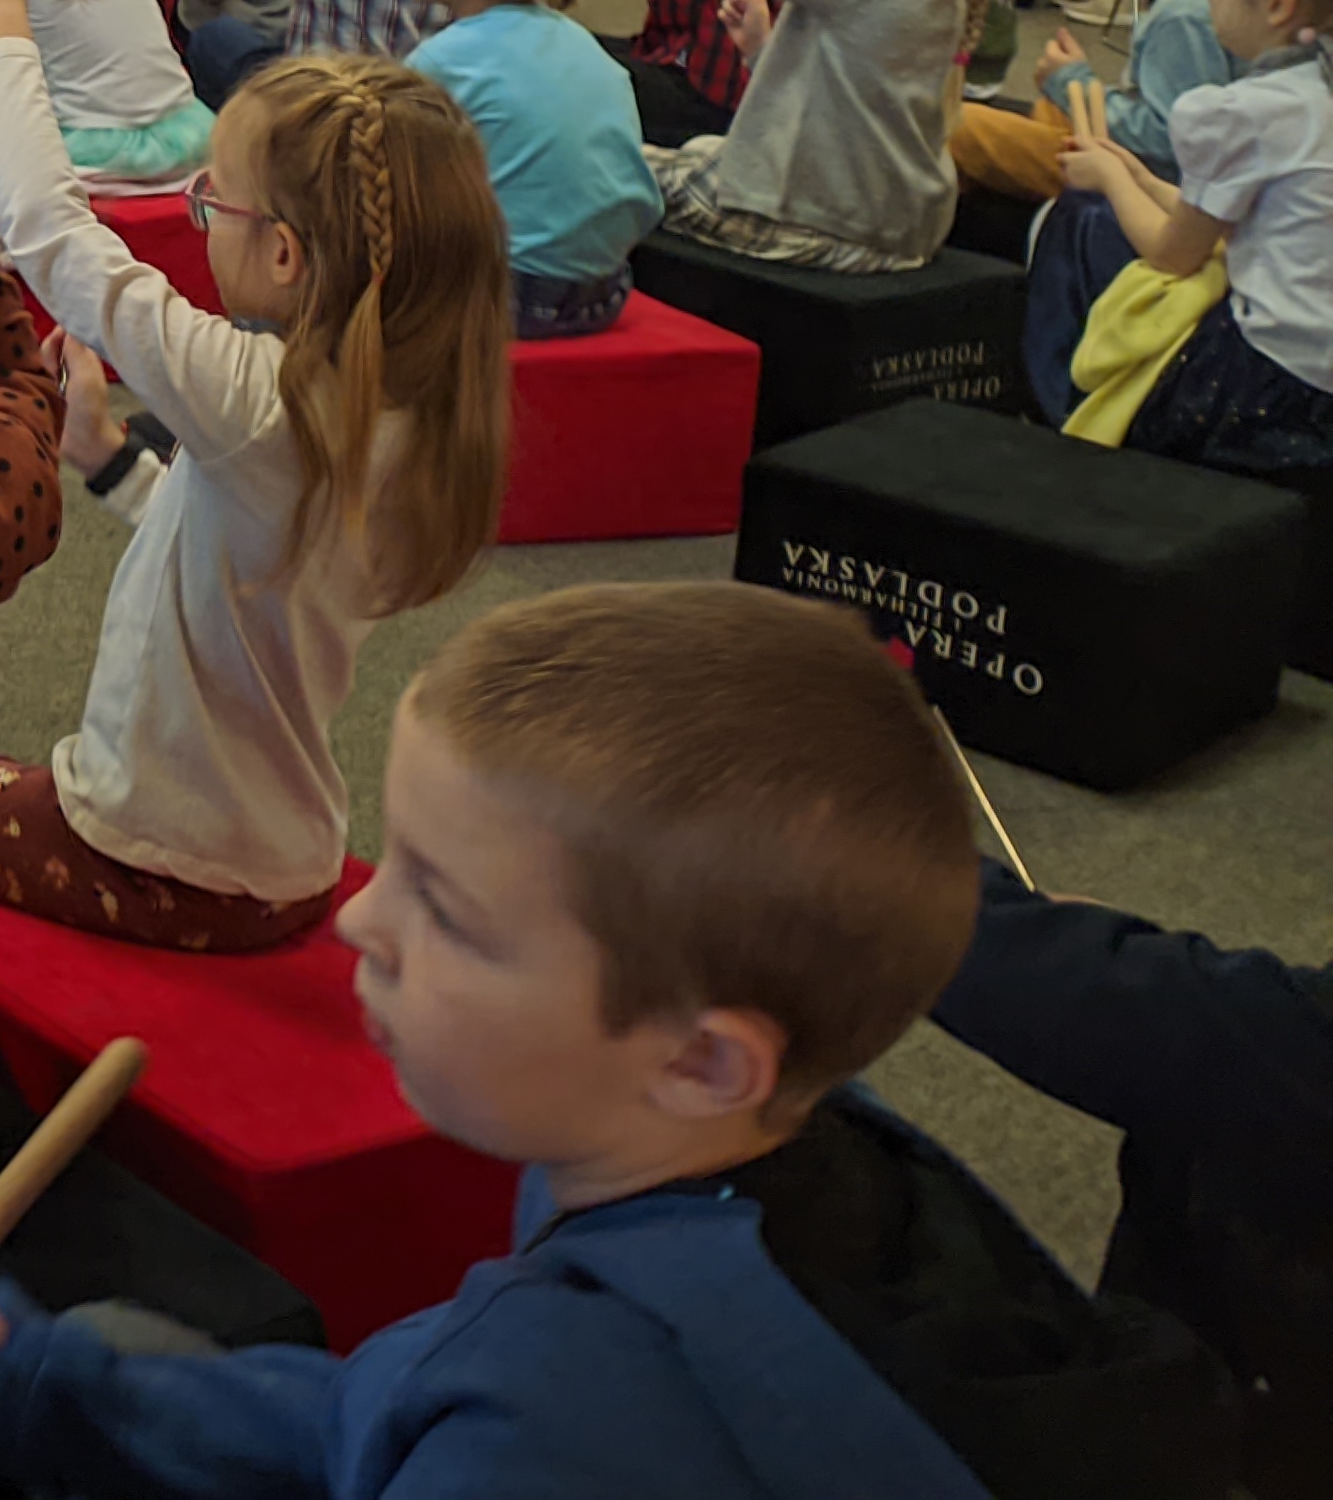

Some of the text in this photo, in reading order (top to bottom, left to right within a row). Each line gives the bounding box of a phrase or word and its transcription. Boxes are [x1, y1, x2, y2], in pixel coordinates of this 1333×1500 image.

[782, 540, 1009, 636] PODLASKA
[782, 565, 945, 629] FILHARMONIA
[904, 619, 1044, 697] OPERA
